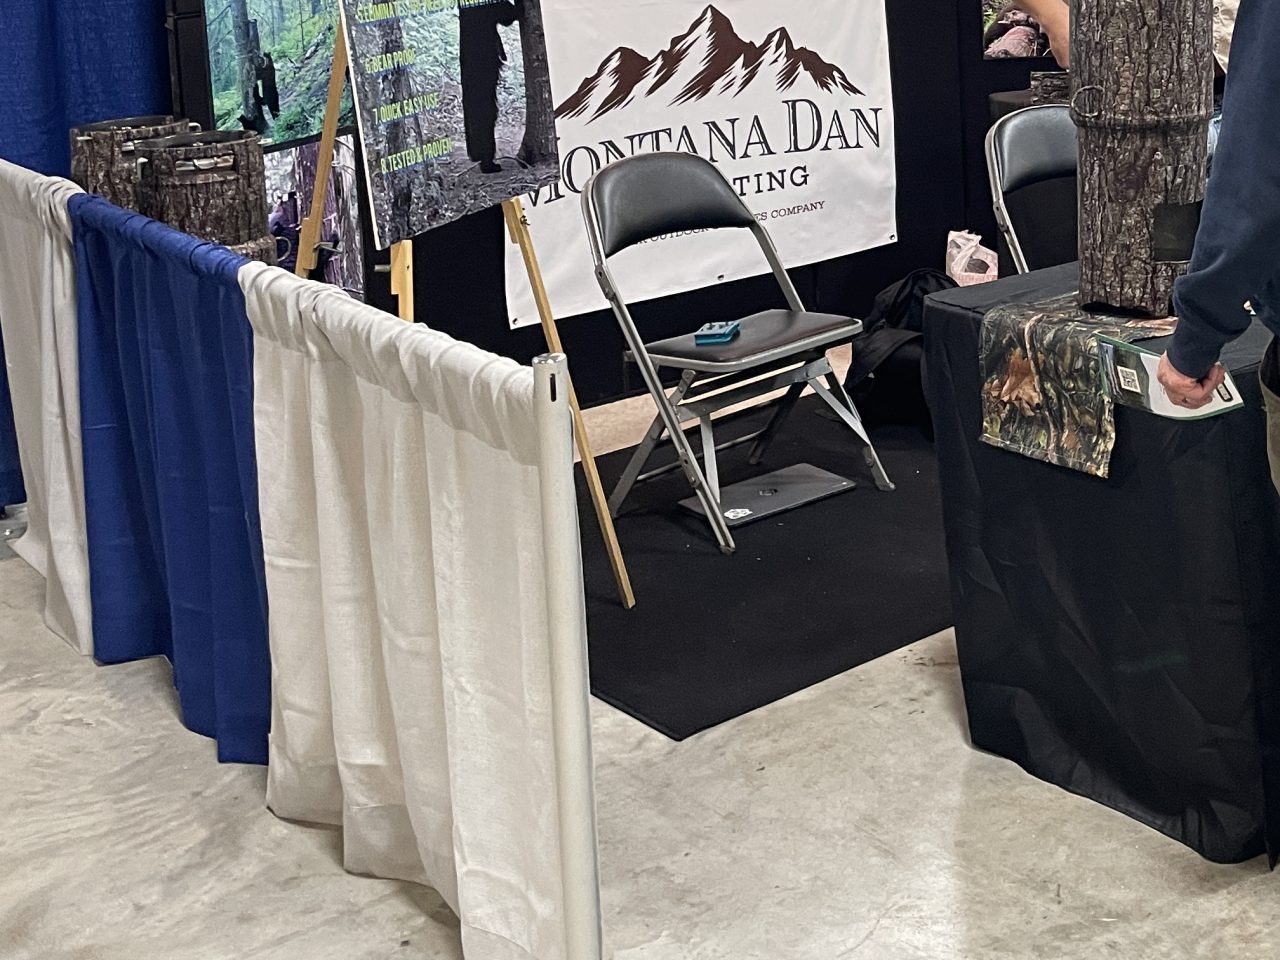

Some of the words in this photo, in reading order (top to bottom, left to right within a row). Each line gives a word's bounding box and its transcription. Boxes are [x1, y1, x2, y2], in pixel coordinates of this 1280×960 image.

[373, 52, 394, 72] BEAR
[380, 102, 403, 123] QUICK
[403, 95, 424, 116] EASY
[423, 91, 440, 111] USE
[783, 98, 883, 155] DAN
[388, 149, 415, 171] TESTED
[423, 137, 453, 160] PROVEN
[771, 200, 825, 219] COMPANY
